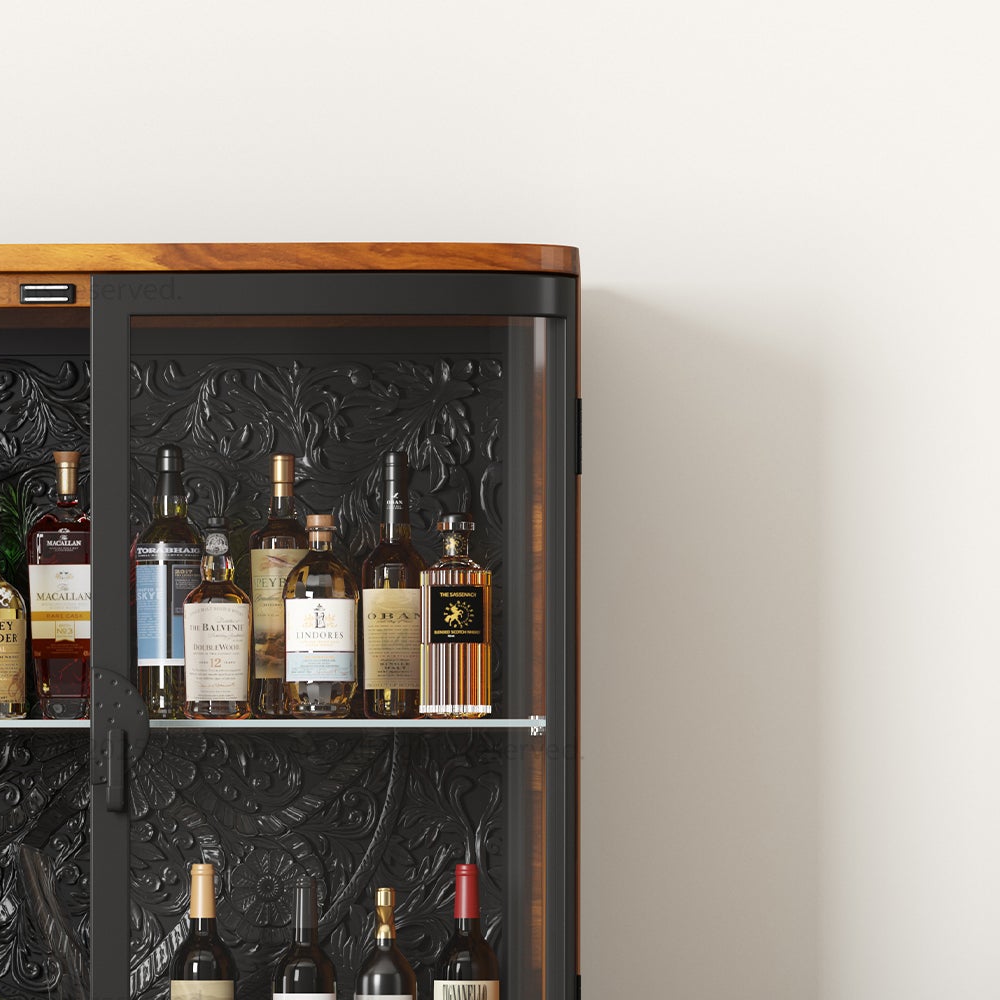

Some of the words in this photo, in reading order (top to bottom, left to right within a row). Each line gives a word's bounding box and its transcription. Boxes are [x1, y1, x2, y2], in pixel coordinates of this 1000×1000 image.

[37, 592, 92, 601] MACALLAN
[296, 631, 344, 640] LINDORES
[210, 657, 221, 668] 12
